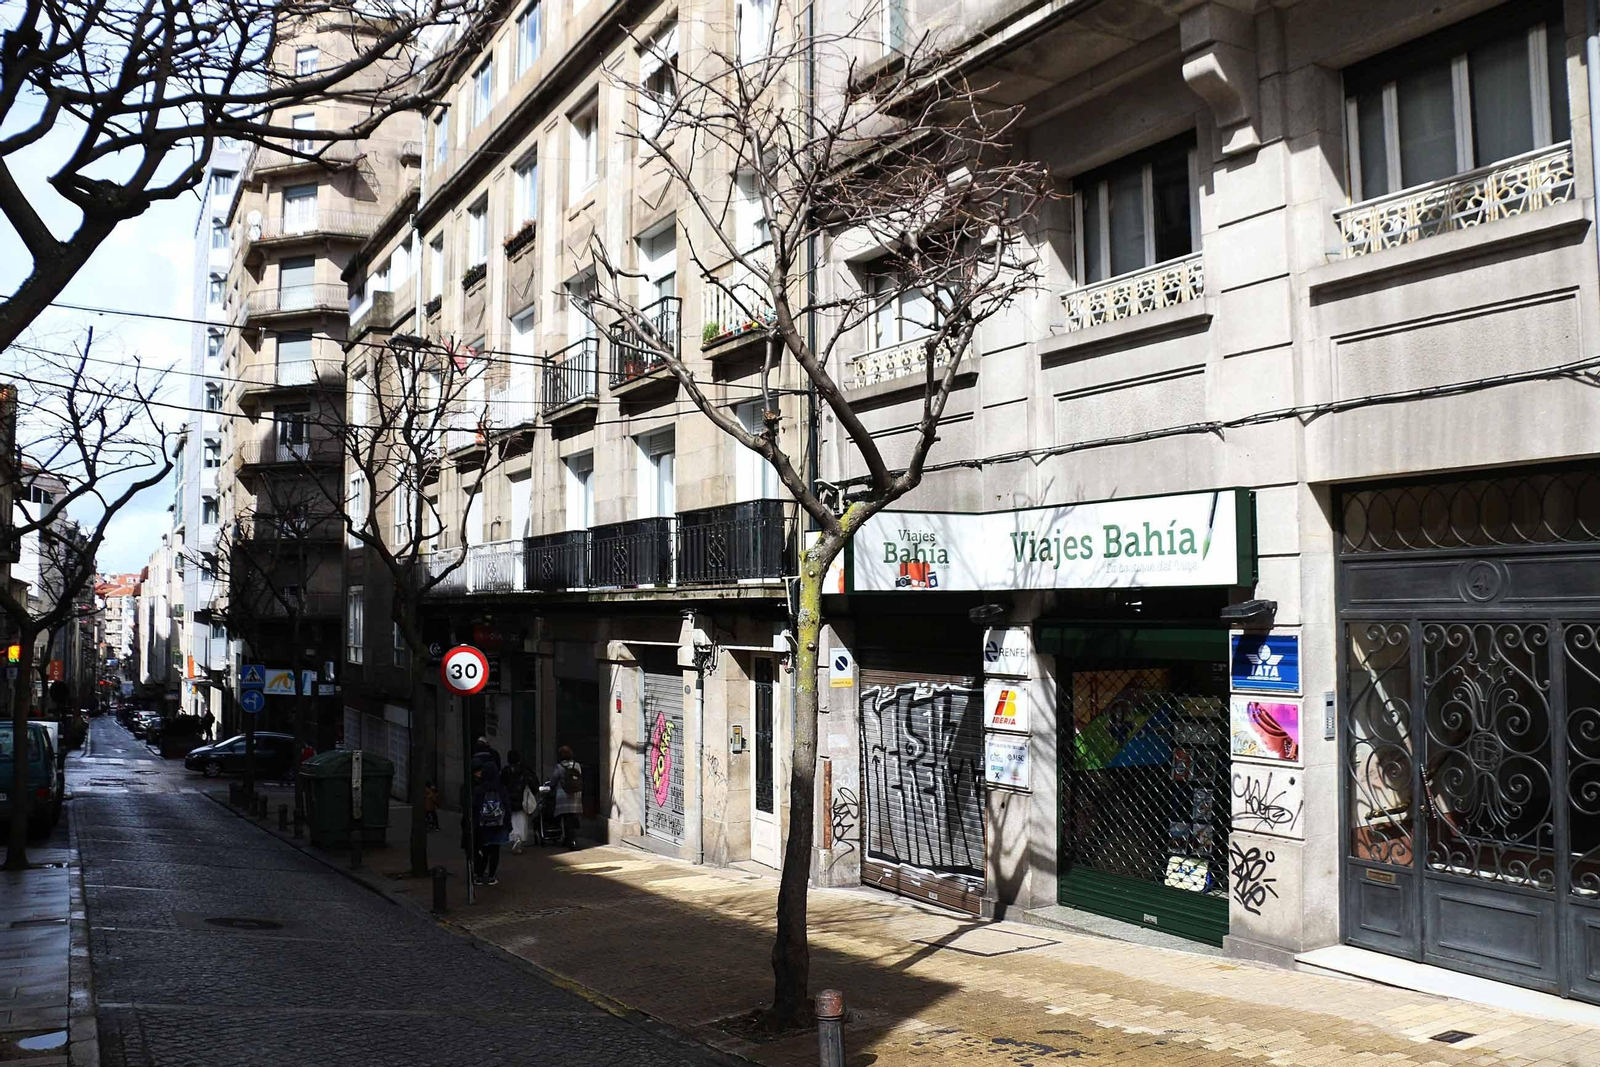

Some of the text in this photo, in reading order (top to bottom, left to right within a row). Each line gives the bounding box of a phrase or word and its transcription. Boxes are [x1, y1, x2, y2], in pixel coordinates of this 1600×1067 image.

[898, 529, 936, 545] Viajes
[1010, 519, 1198, 571] Viajes Bahía
[883, 541, 950, 565] Bahía
[999, 646, 1026, 658] RENFE
[451, 663, 477, 679] 30
[1250, 665, 1279, 677] IATA
[992, 716, 1017, 726] IBERIA
[1012, 753, 1025, 762] MSC
